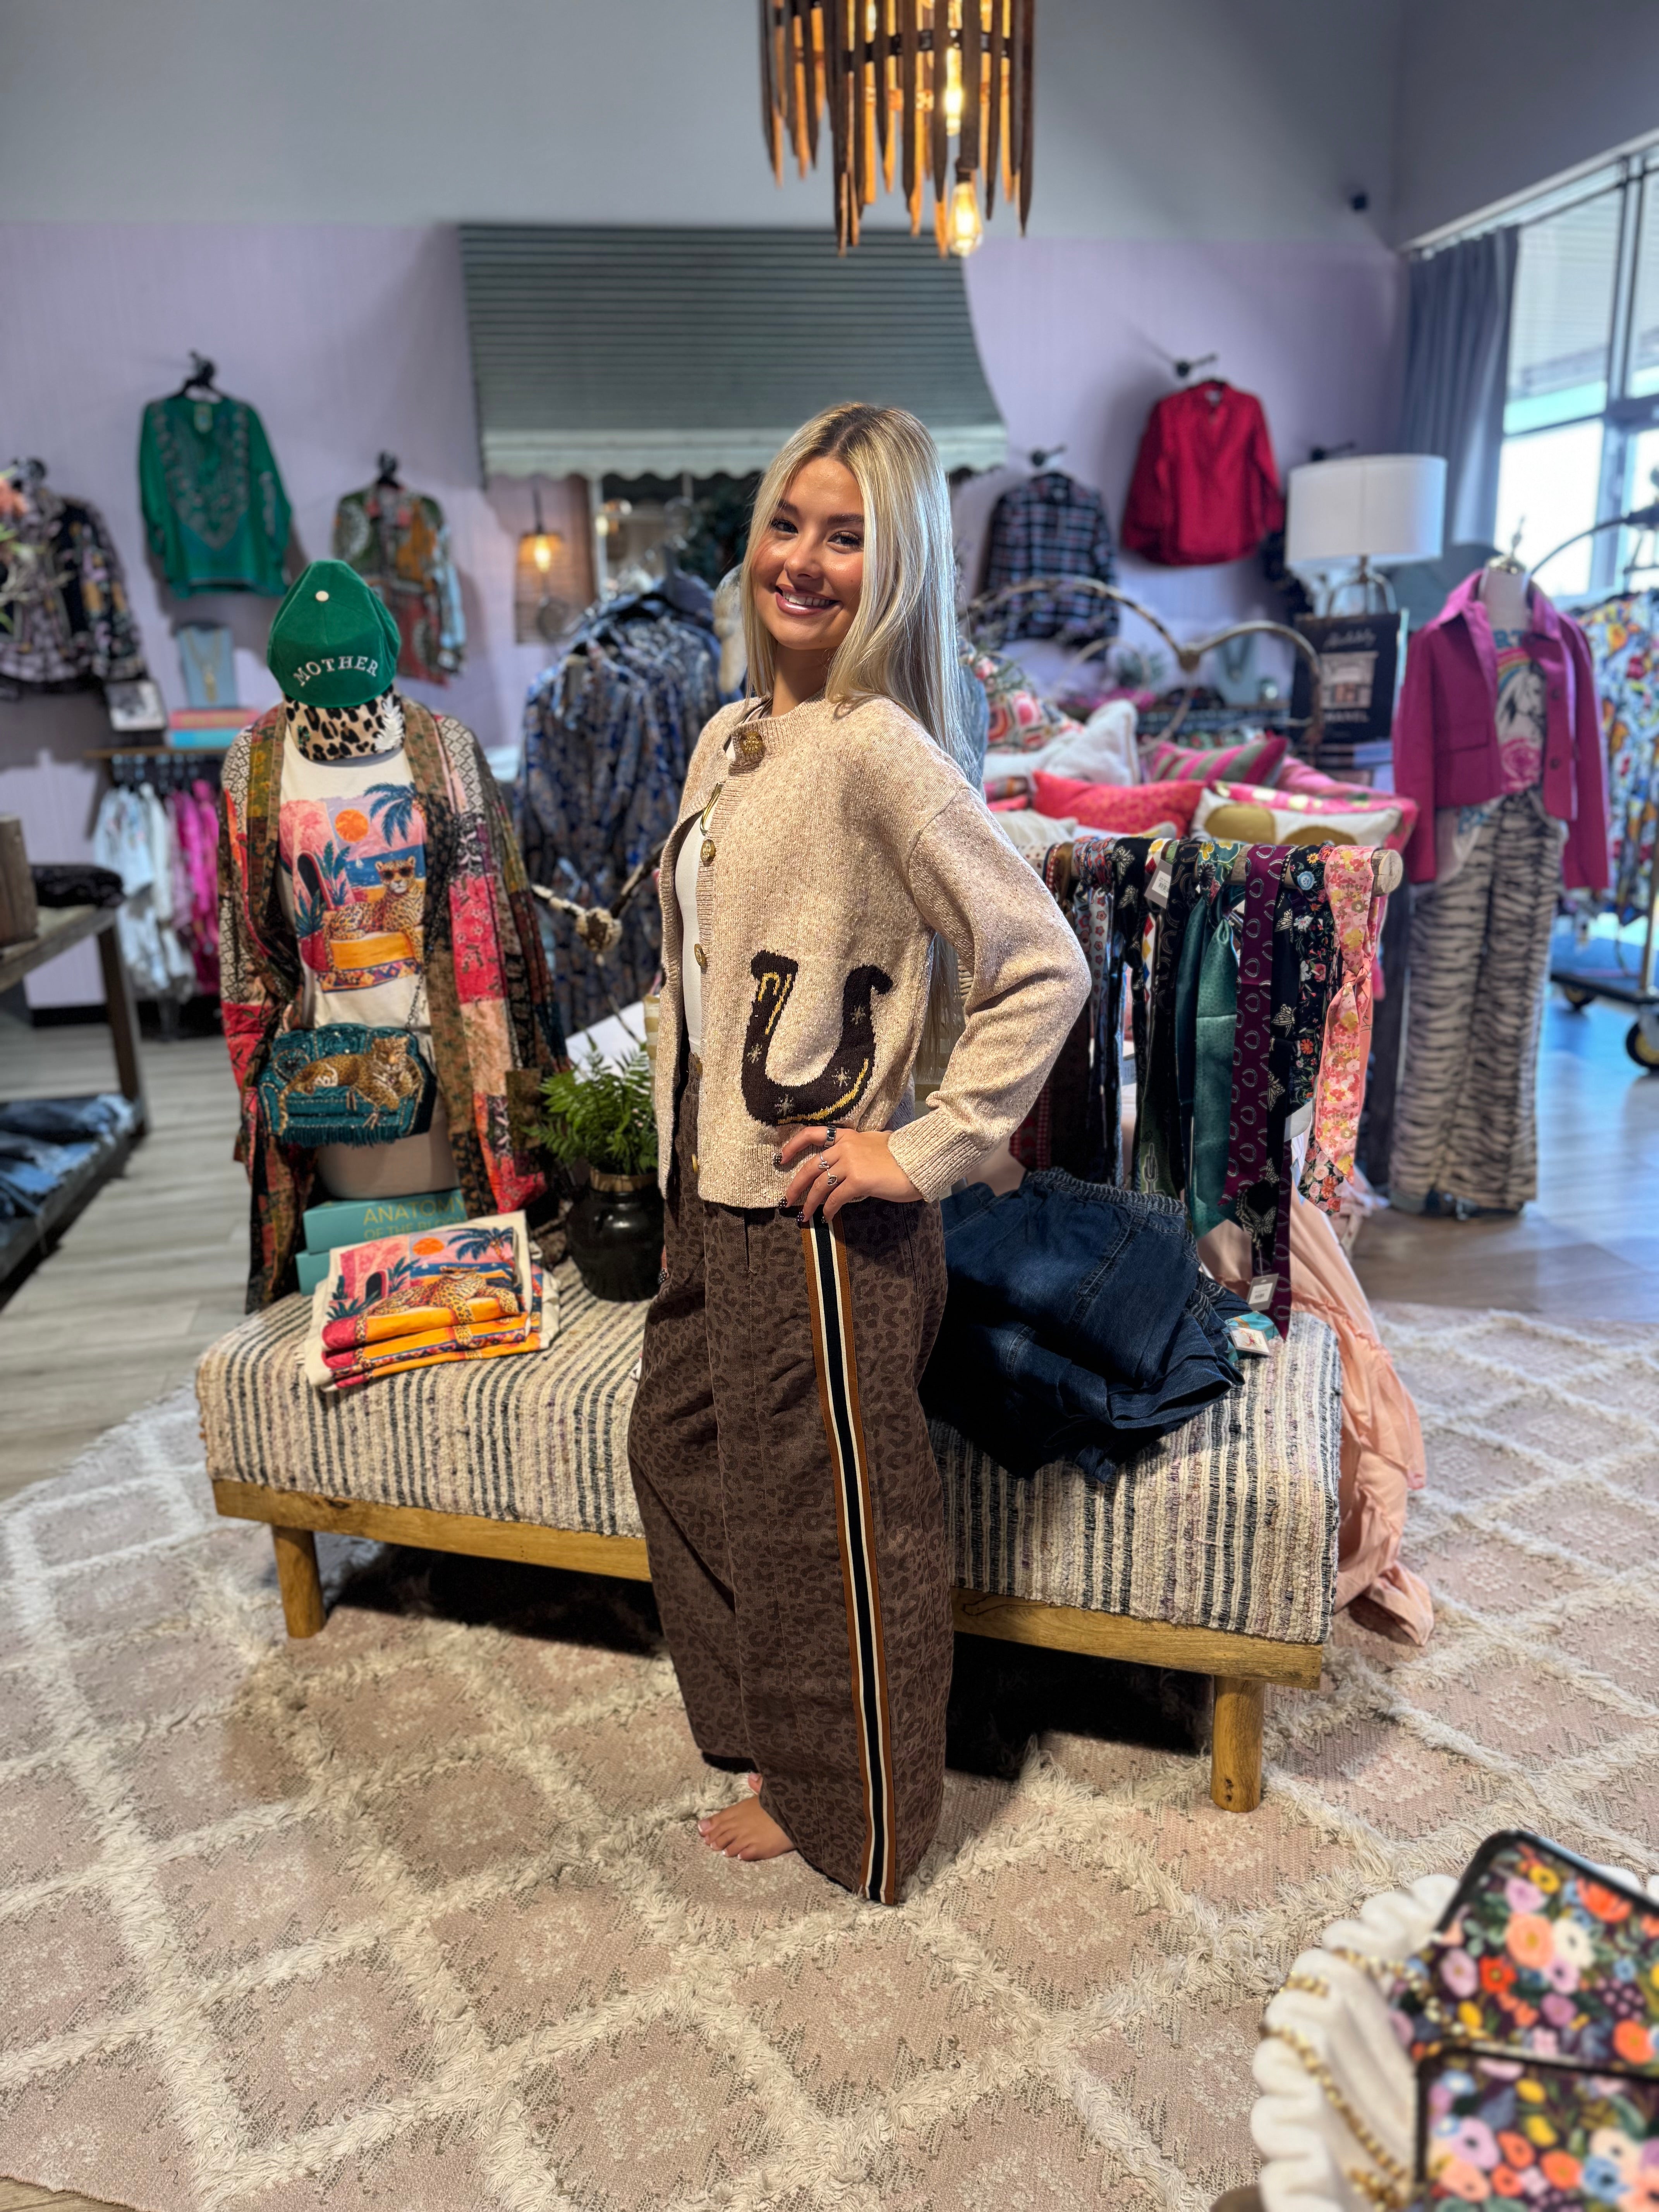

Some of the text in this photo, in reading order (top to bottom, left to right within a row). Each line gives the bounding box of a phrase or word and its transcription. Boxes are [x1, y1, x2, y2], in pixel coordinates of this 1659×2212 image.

[293, 656, 378, 687] MOTHER
[363, 1195, 464, 1225] ANATOMY
[363, 1227, 383, 1240] OF
[387, 1222, 415, 1237] THE
